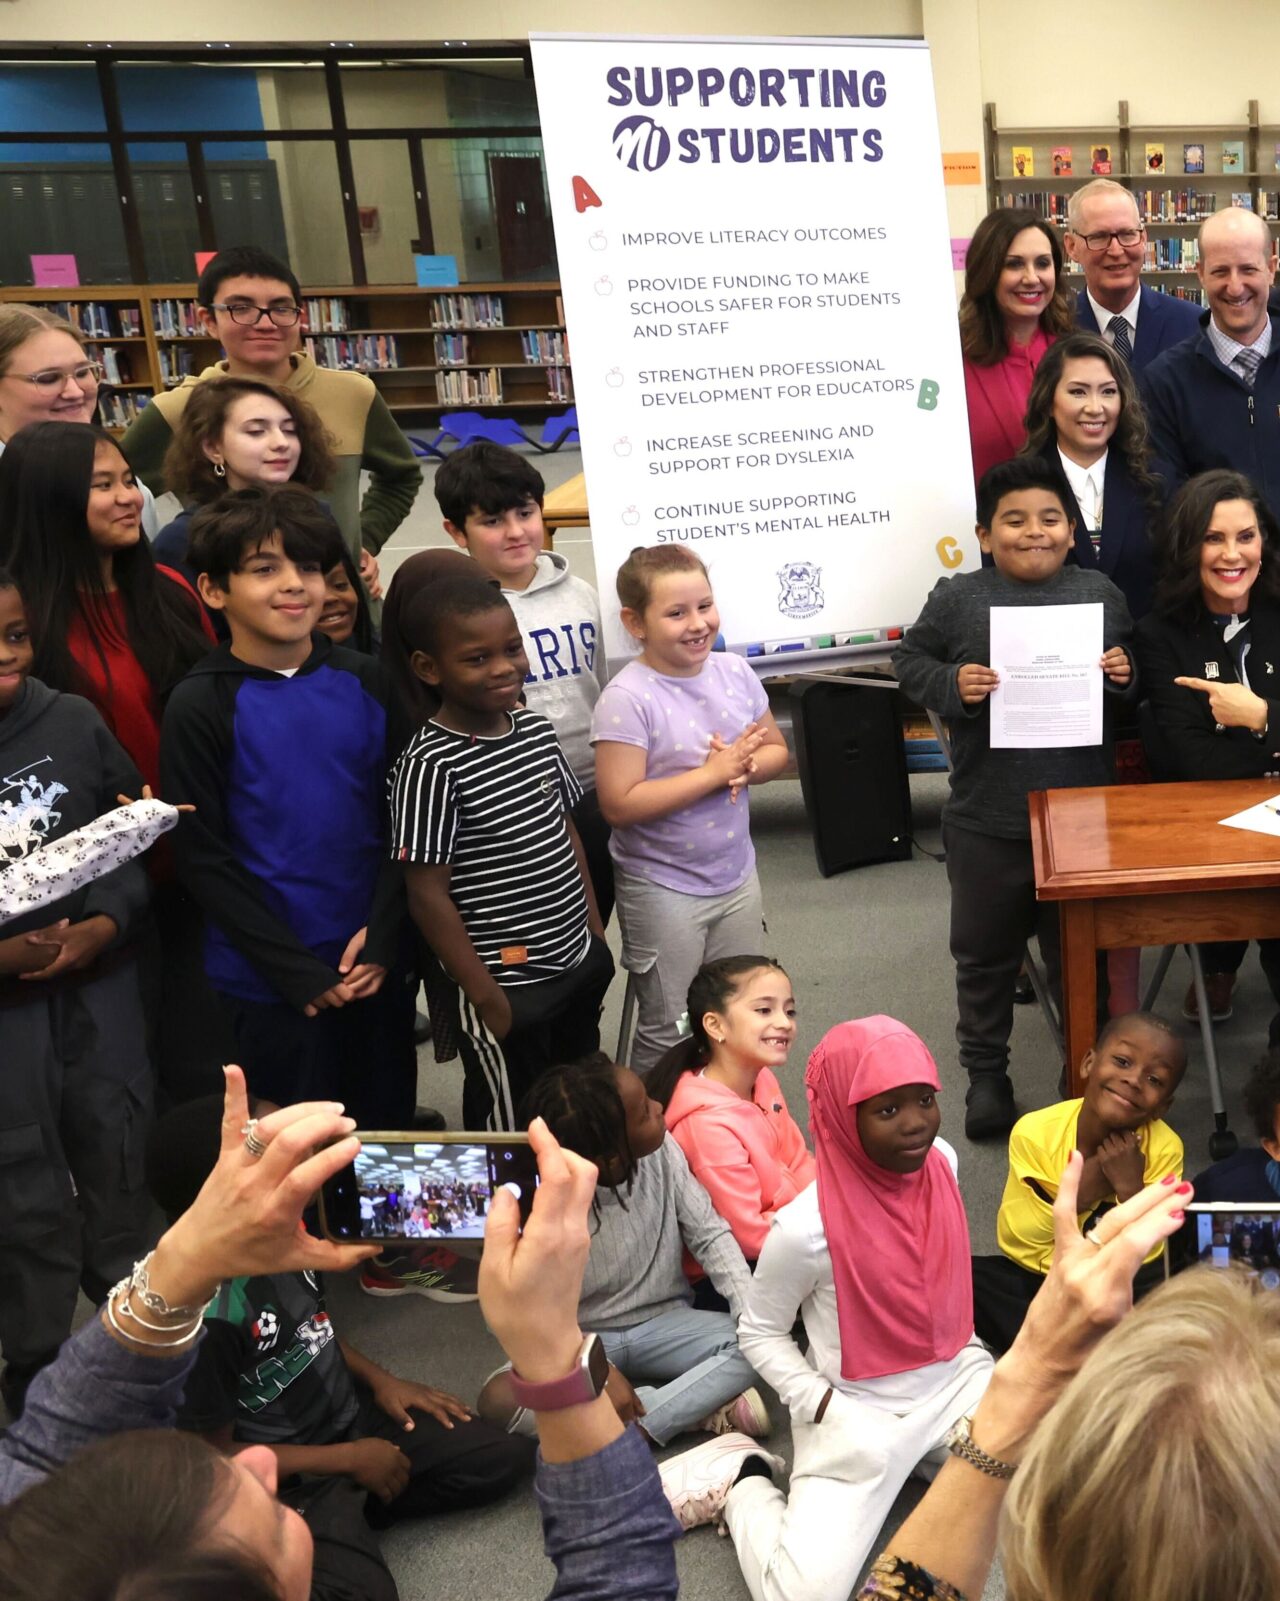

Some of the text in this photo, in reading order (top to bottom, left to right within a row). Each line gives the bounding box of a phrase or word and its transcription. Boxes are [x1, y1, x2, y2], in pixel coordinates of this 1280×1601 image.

[607, 66, 886, 108] SUPPORTING
[678, 128, 883, 163] STUDENTS
[571, 175, 602, 214] A
[623, 228, 886, 245] IMPROVE LITERACY OUTCOMES
[628, 272, 869, 292] PROVIDE FUNDING TO MAKE
[631, 293, 900, 315] SCHOOLS SAFER FOR STUDENTS
[634, 322, 728, 338] AND STAFF
[639, 359, 884, 383] STRENGTHEN PROFESSIONAL
[642, 379, 914, 406] DEVELOPMENT FOR EDUCATORS
[917, 378, 940, 411] B
[647, 425, 873, 452] INCREASE SCREENING AND
[649, 448, 854, 474] SUPPORT FOR DYSLEXIA
[655, 492, 856, 519] CONTINUE SUPPORTING
[657, 509, 890, 542] STUDENT'S MENTAL HEALTH
[936, 536, 963, 569] C
[524, 622, 596, 684] RIS
